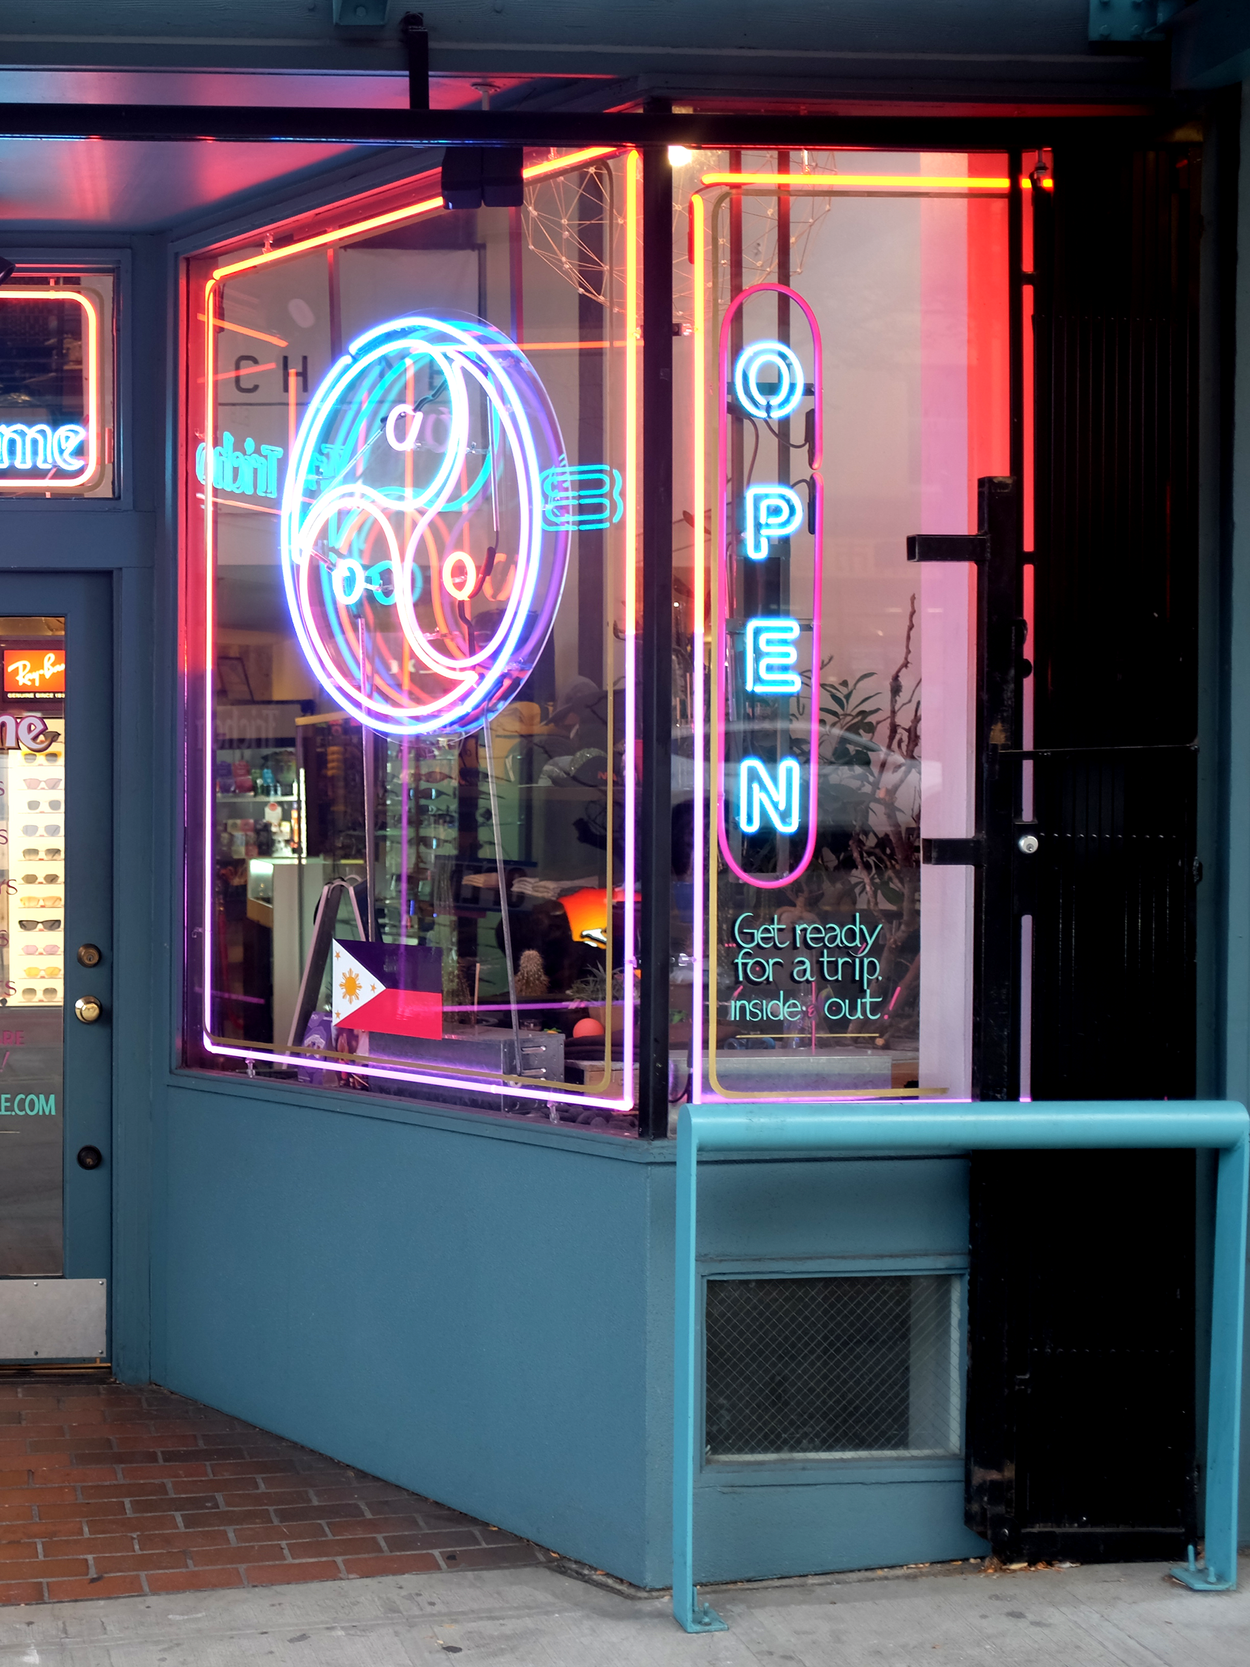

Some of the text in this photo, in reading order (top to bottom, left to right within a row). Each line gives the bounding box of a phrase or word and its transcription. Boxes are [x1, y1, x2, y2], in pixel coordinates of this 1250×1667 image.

[735, 340, 804, 835] OPEN
[734, 912, 883, 957] Get ready
[734, 949, 784, 982] for
[793, 957, 816, 981] a
[730, 990, 802, 1021] inside
